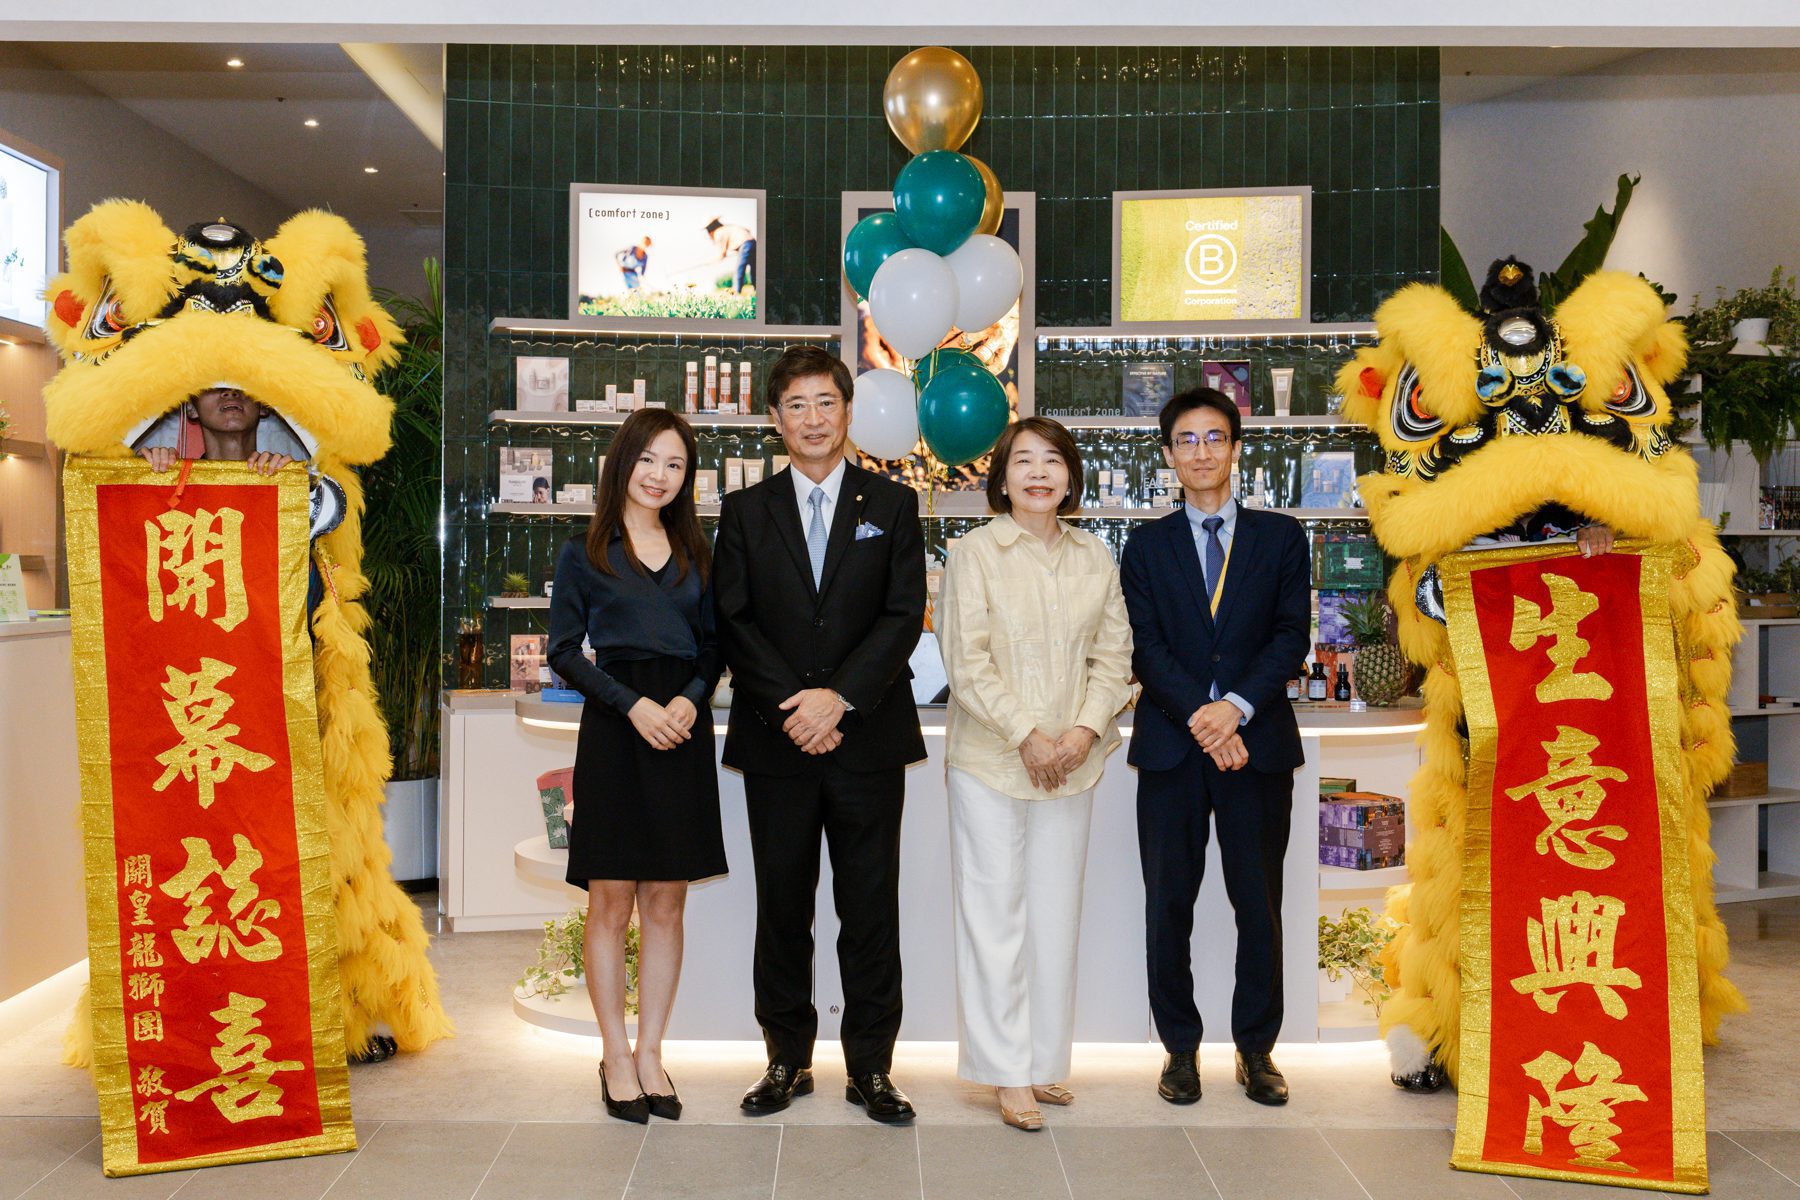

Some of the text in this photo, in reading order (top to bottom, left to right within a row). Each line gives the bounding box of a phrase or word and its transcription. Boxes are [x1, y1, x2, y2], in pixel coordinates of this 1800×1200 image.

[1185, 220, 1238, 231] Certified
[1199, 244, 1225, 275] B
[1184, 297, 1238, 305] Corporation
[145, 507, 304, 1124] 開幕誌喜
[1504, 572, 1649, 1174] 生意興隆
[136, 1064, 173, 1135] 敬賀
